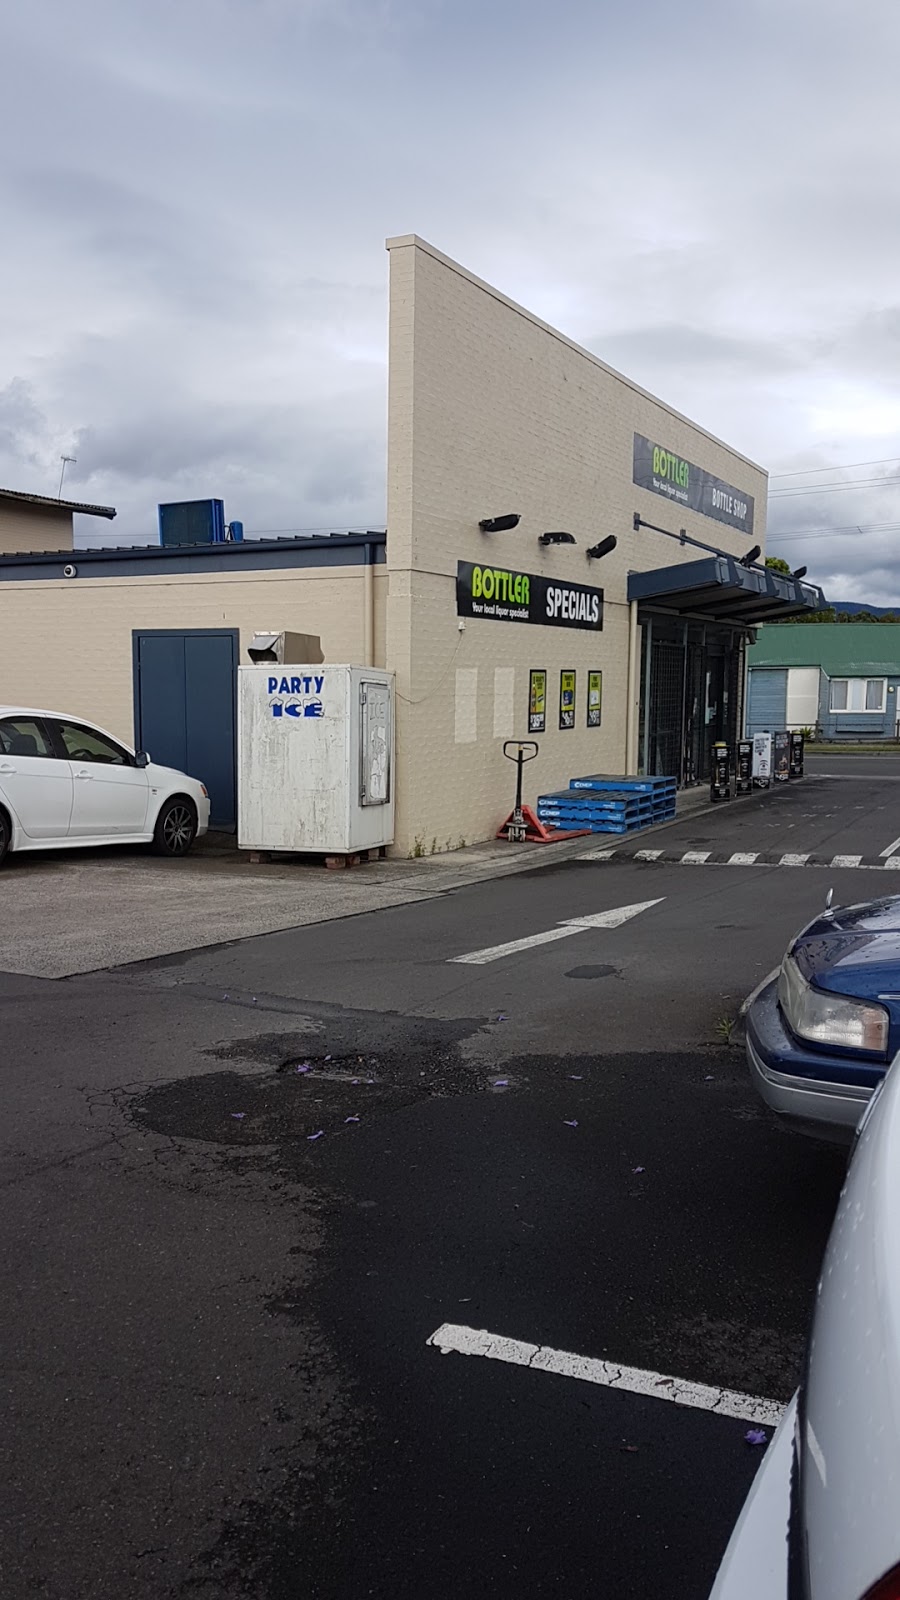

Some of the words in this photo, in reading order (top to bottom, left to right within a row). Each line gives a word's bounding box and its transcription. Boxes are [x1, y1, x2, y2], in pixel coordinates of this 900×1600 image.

[653, 446, 689, 488] BOTTLER
[712, 488, 732, 514] BOTTLE
[733, 499, 748, 520] SHOP
[472, 566, 530, 604] BOTTLER
[472, 602, 483, 613] Your
[484, 603, 495, 615] local
[495, 605, 509, 618] liquor
[509, 607, 529, 620] specialist
[546, 586, 599, 622] SPECIALS
[268, 676, 324, 694] PARTY
[269, 697, 324, 718] ICE
